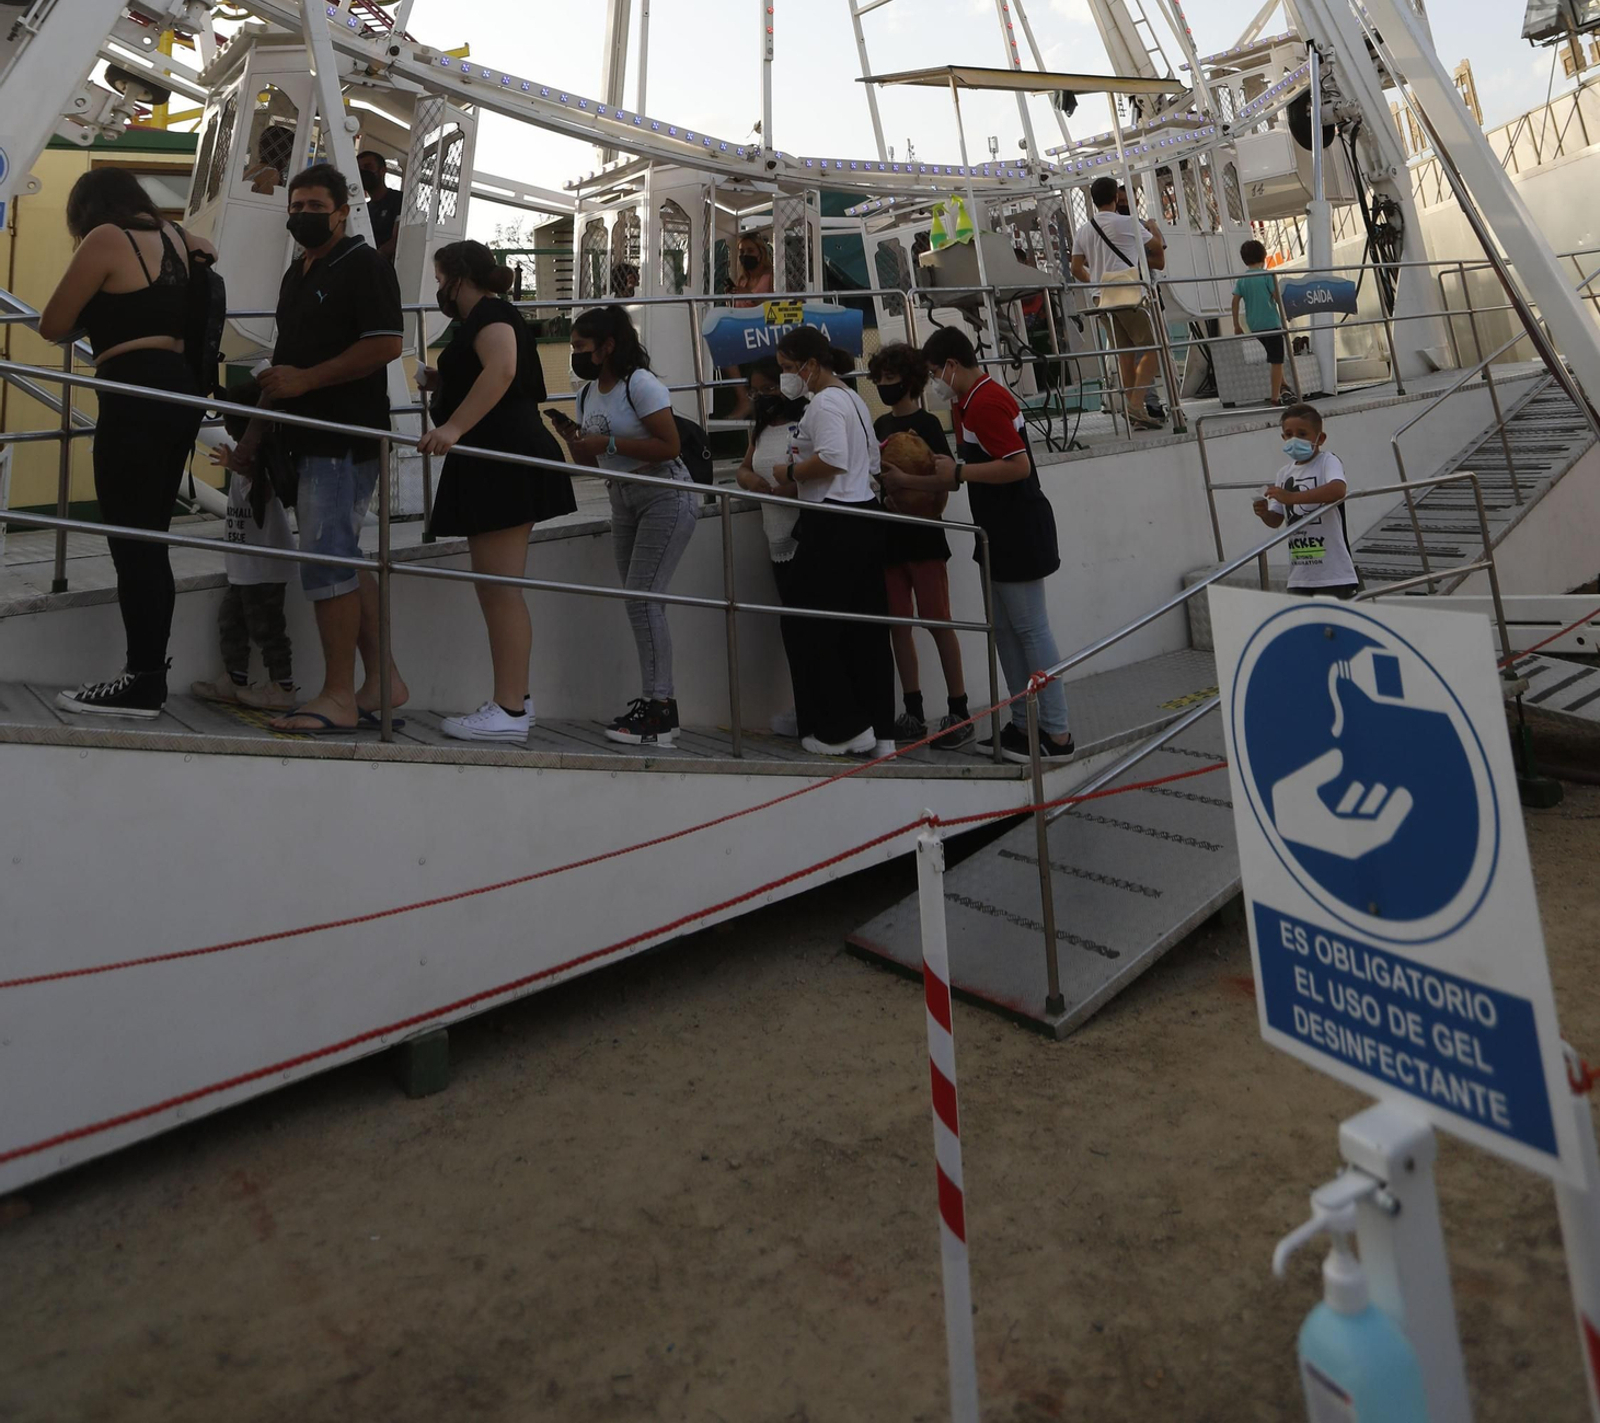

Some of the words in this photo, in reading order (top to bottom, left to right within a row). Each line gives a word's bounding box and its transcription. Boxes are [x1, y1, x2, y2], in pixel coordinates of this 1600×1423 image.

[743, 322, 831, 350] ENTA
[1305, 285, 1334, 305] SAÍDA
[1279, 919, 1309, 956] ES
[1314, 934, 1498, 1029] OBLIGATORIO
[1294, 965, 1325, 1005] EL
[1327, 979, 1382, 1027] USO
[1387, 1003, 1426, 1049] DE
[1431, 1022, 1494, 1075] GEL
[1293, 1003, 1513, 1128] DESINFECTANTE
